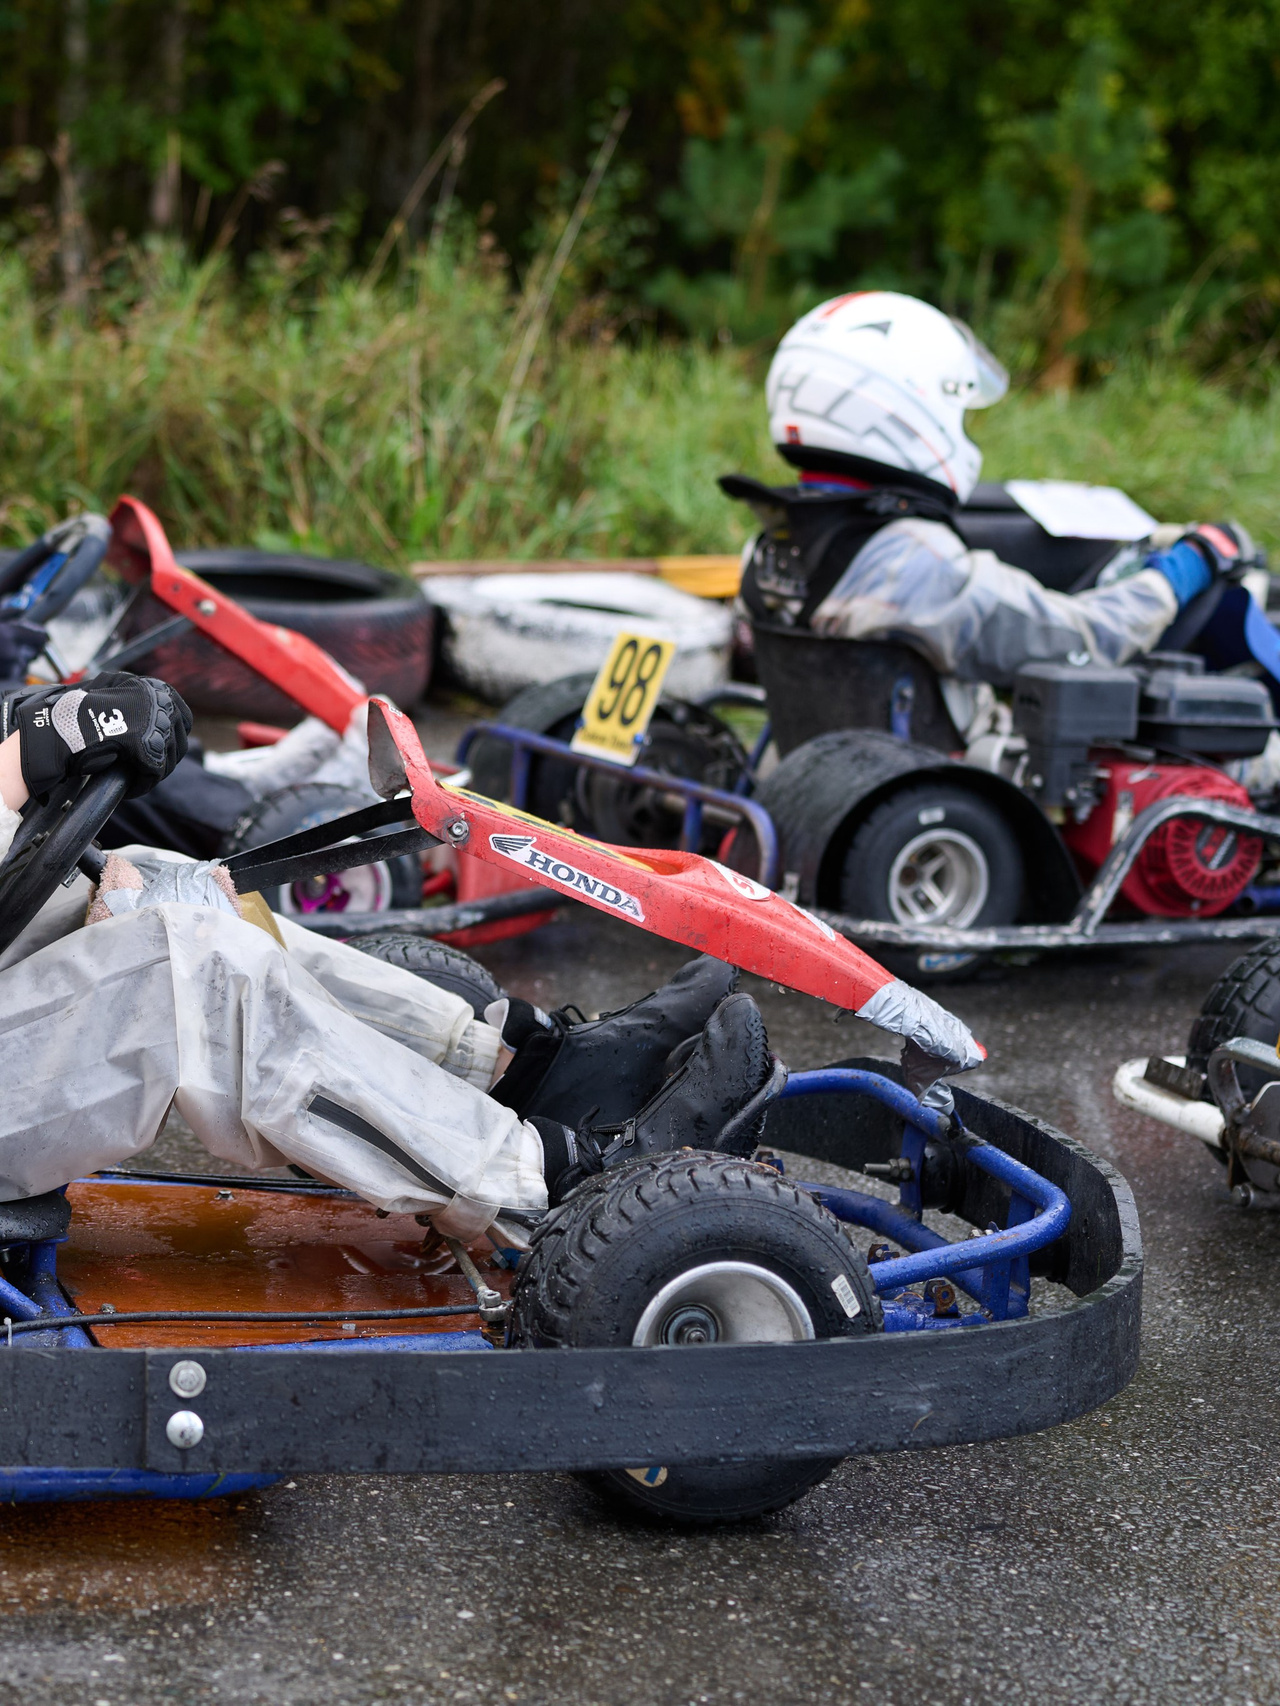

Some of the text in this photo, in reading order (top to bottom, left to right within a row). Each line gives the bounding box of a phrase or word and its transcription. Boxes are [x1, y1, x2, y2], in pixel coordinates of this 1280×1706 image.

[598, 639, 663, 727] 98
[32, 709, 46, 728] Tip
[524, 849, 640, 917] HONDA
